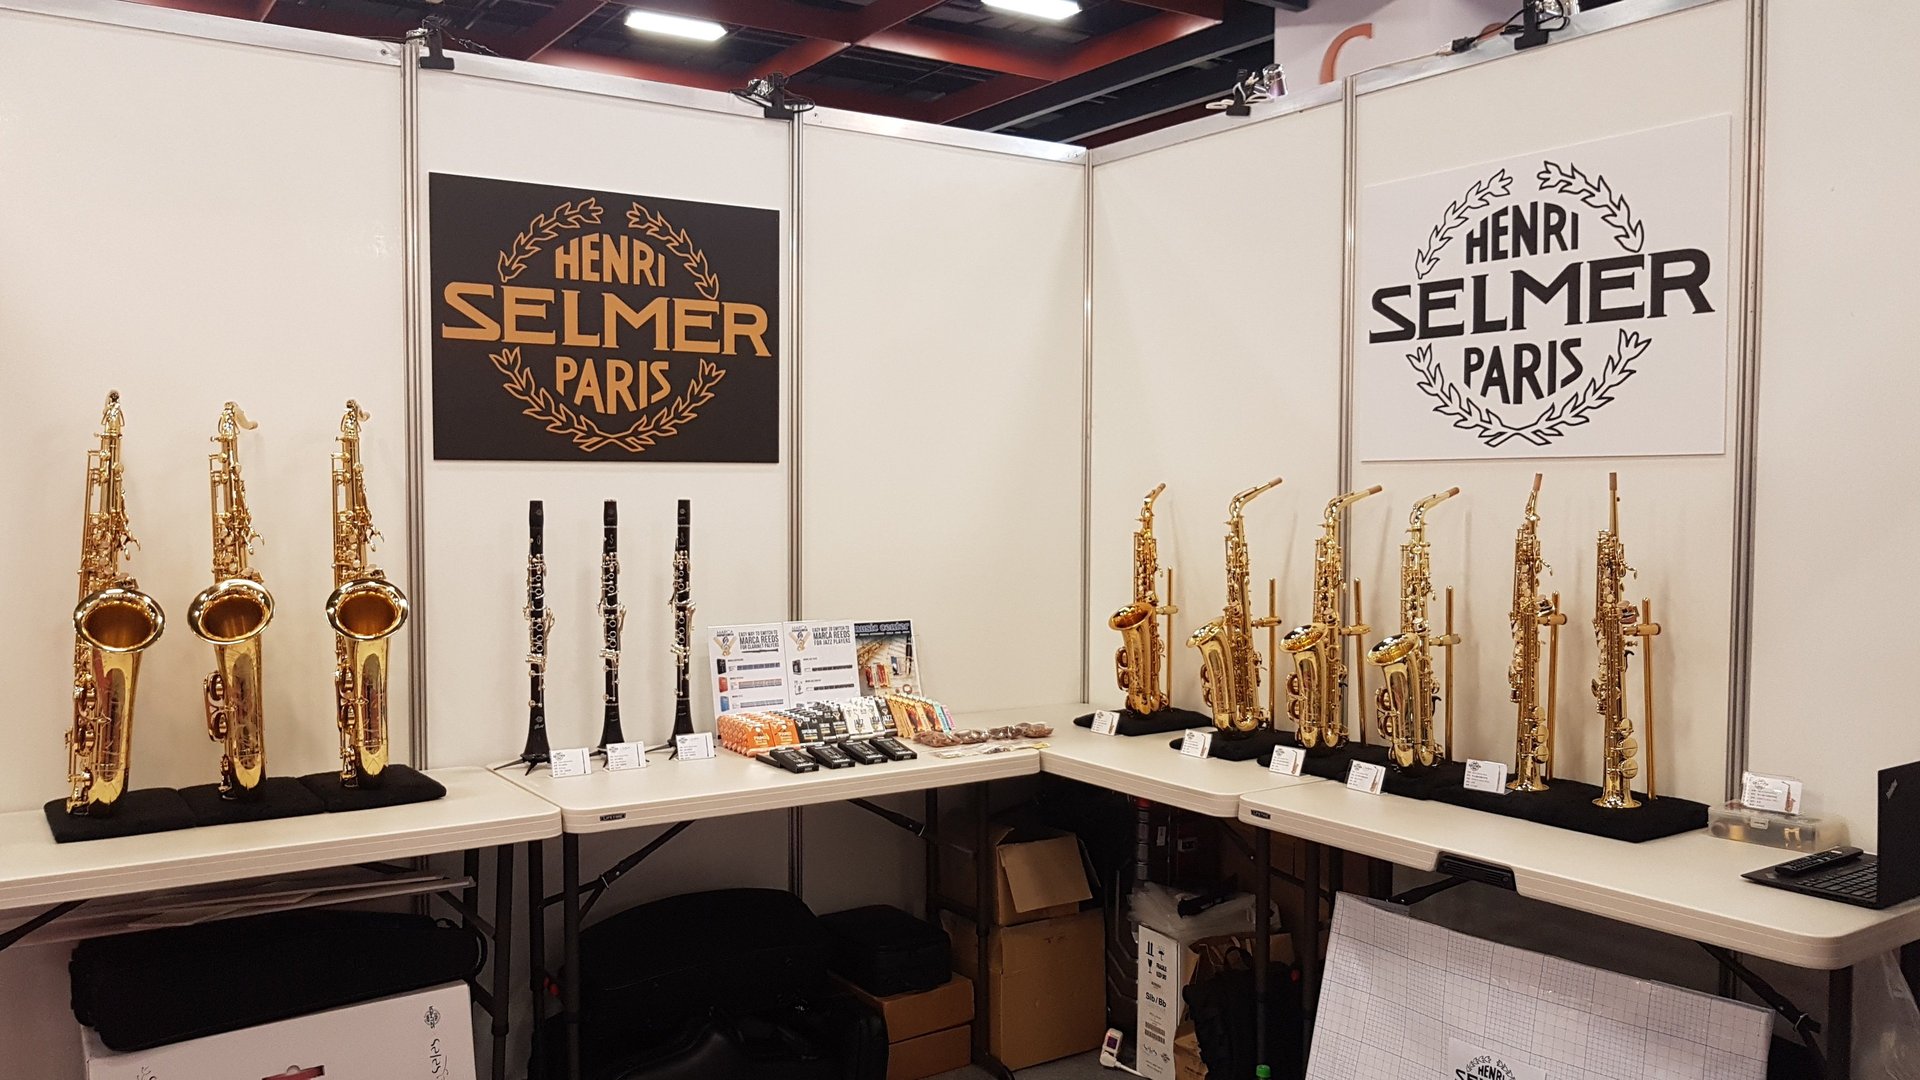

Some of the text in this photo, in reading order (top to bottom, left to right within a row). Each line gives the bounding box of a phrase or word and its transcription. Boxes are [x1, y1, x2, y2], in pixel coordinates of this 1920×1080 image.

[555, 232, 666, 288] HENRI
[1465, 201, 1578, 265] HENRI
[441, 281, 773, 358] SELMER
[1368, 248, 1716, 344] SELMER
[555, 355, 672, 415] PARIS
[1463, 337, 1584, 405] PARIS
[739, 634, 779, 645] MARCA REEDS
[813, 631, 832, 640] MARCA
[833, 630, 850, 638] REEDS
[1478, 1065, 1505, 1080] HENRI
